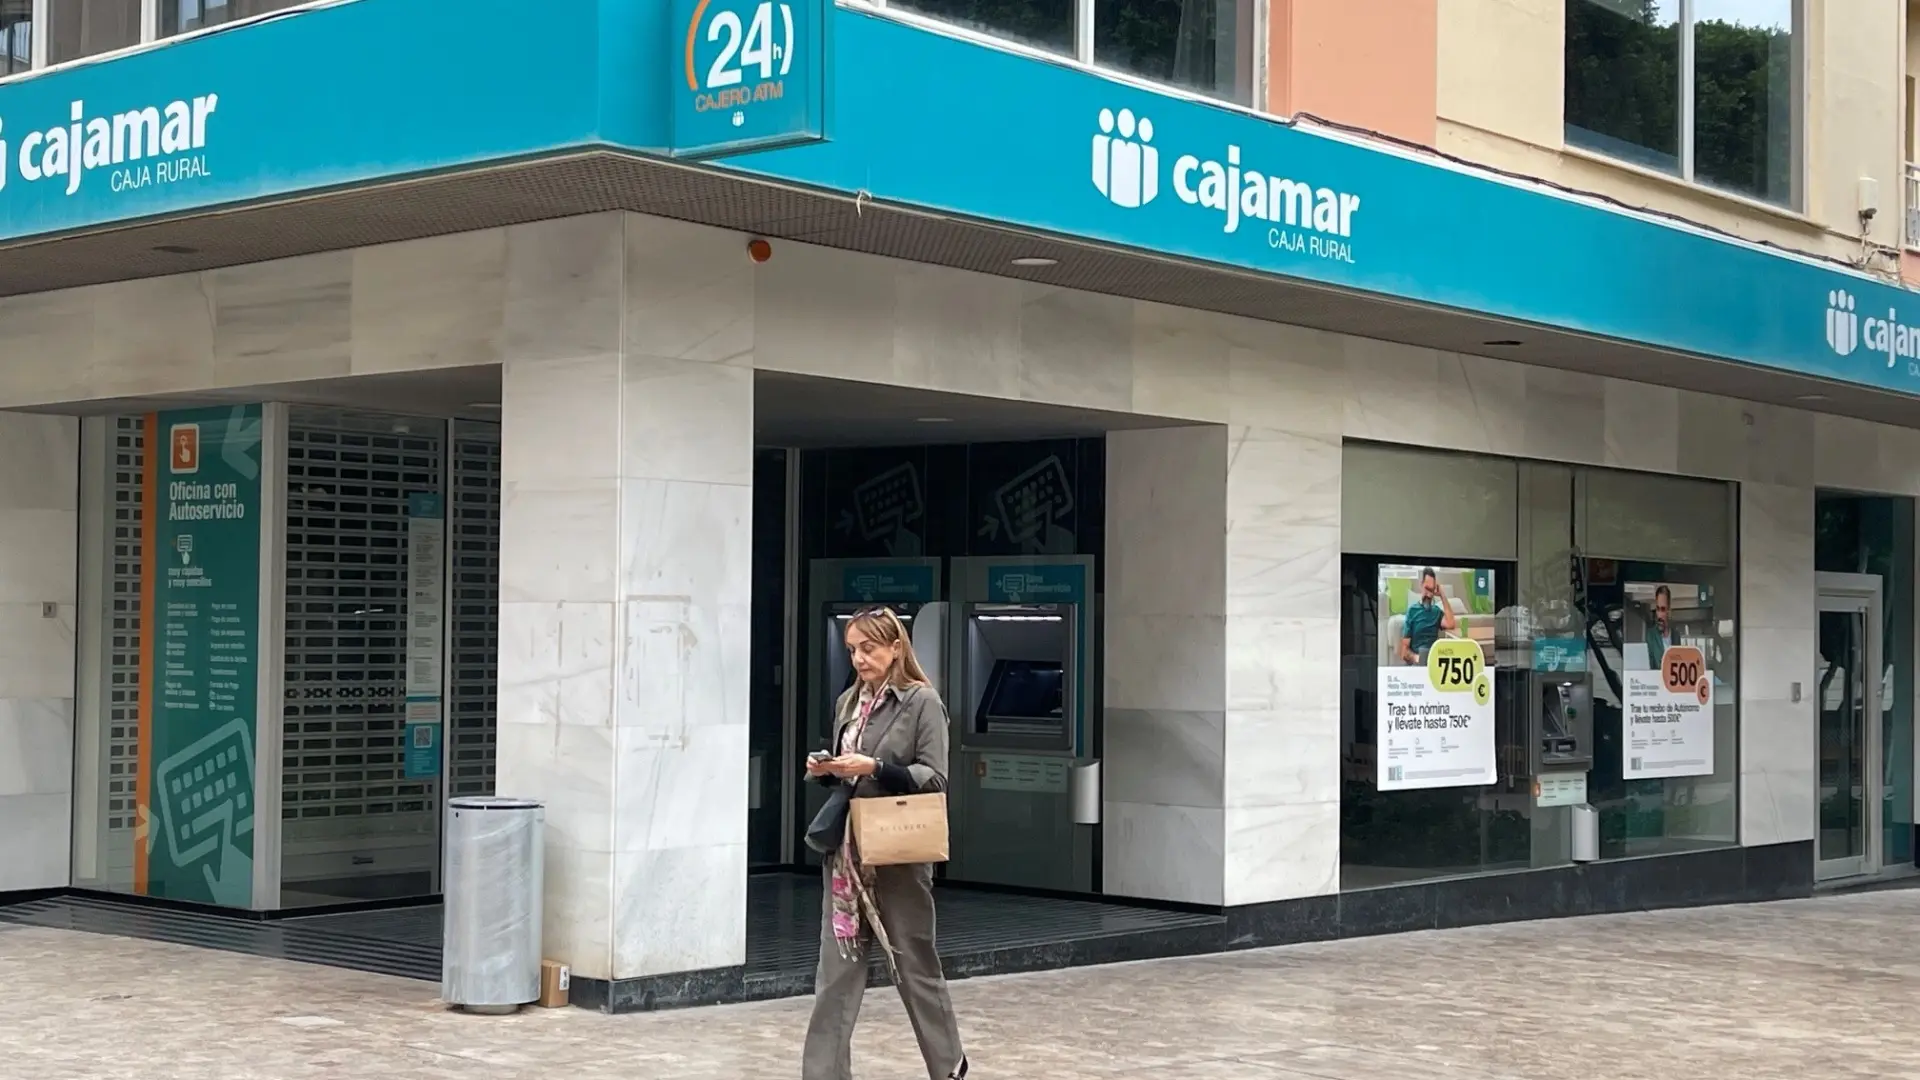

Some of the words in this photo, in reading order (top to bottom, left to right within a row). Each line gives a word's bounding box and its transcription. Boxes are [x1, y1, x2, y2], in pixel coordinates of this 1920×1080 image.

[695, 87, 751, 112] CAJERO
[754, 80, 784, 101] ATM
[18, 93, 219, 196] cajamar
[111, 166, 152, 193] CAJA
[156, 154, 212, 184] RURAL
[1172, 144, 1361, 237] cajamar
[1268, 228, 1306, 253] CAJA
[1310, 236, 1356, 264] RURAL
[169, 481, 211, 501] Oficina
[214, 482, 237, 499] con
[169, 500, 244, 520] Autoservicio
[1478, 684, 1485, 697] €
[1388, 703, 1406, 716] Trae
[1408, 704, 1417, 716] tu
[1419, 701, 1450, 715] nómina
[1388, 719, 1394, 733] y
[1395, 716, 1422, 730] llévate
[1424, 716, 1447, 729] hasta
